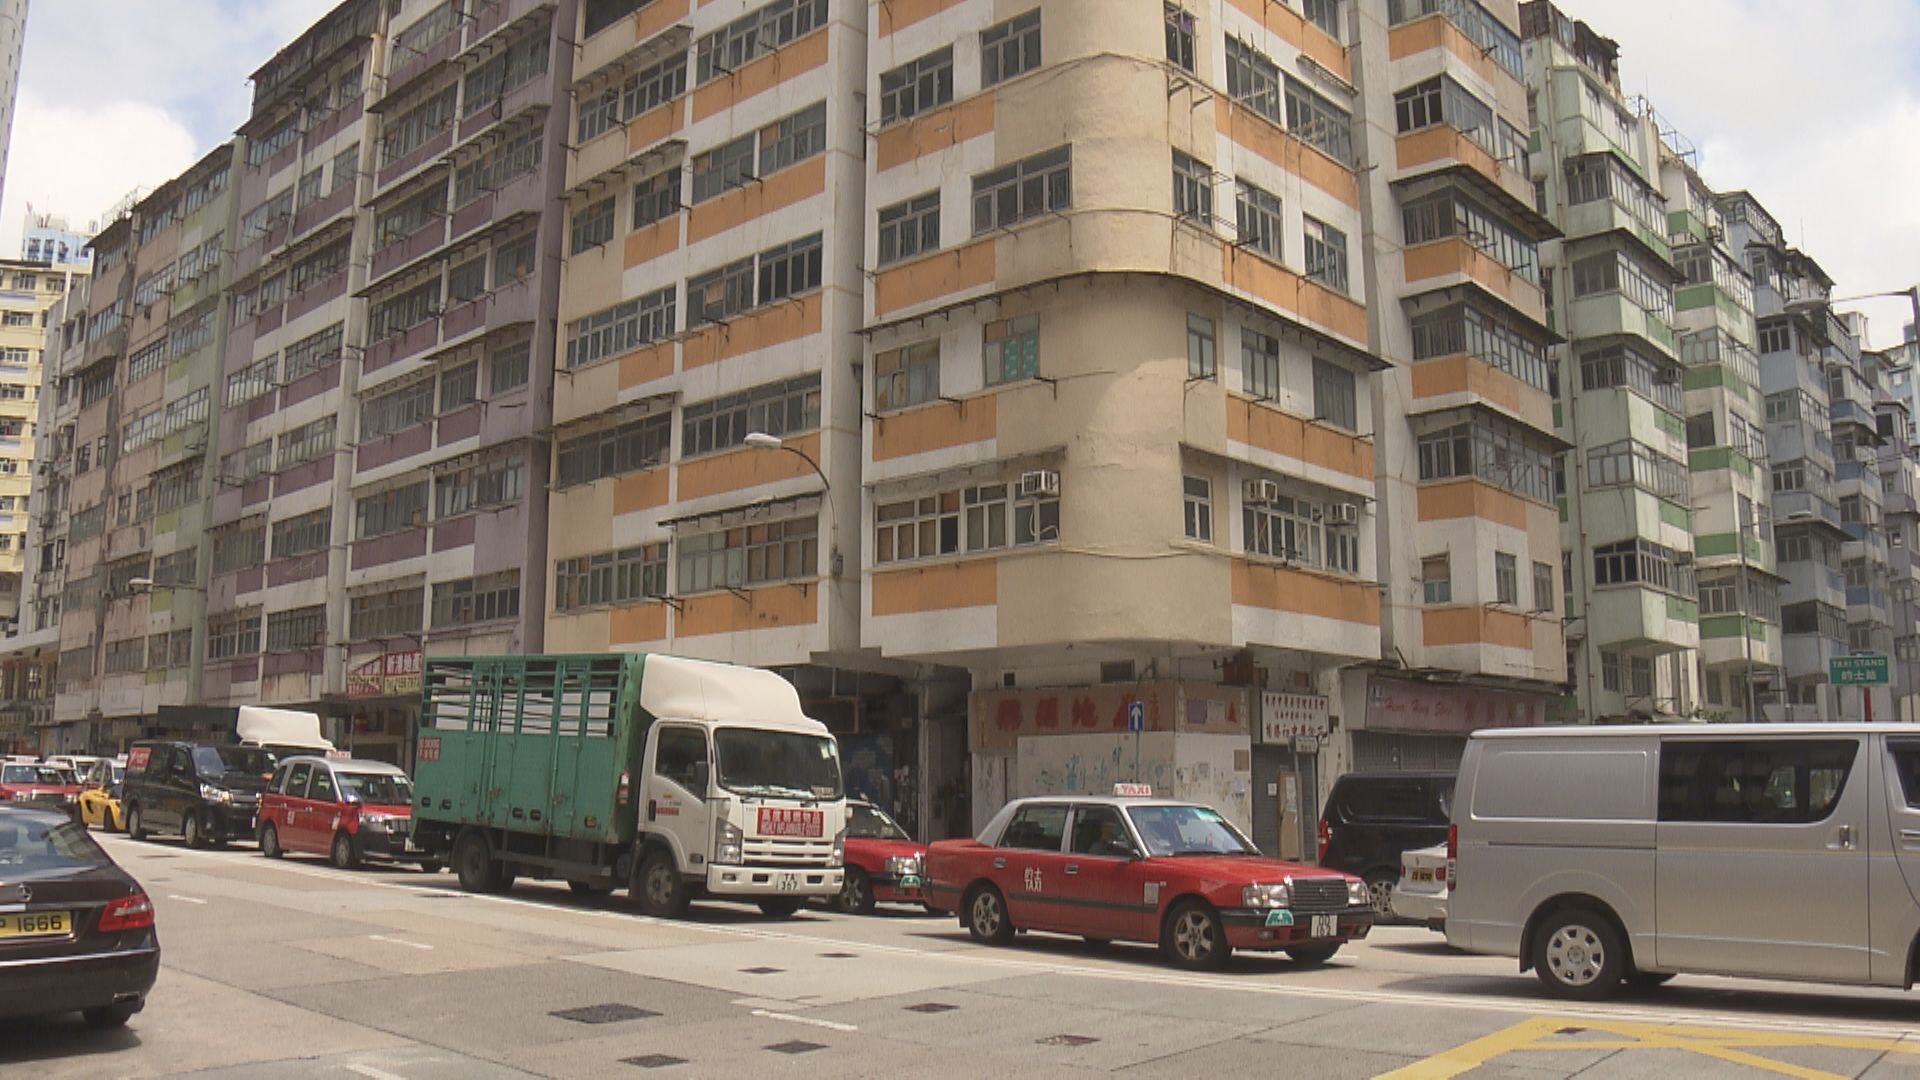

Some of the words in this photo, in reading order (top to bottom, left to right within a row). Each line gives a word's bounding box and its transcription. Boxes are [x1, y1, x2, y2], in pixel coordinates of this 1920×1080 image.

[1833, 660, 1852, 668] TAXI
[1855, 658, 1885, 667] STAND
[1841, 670, 1877, 681] 的士站
[1120, 784, 1149, 795] TAXI
[784, 873, 795, 881] TA
[1024, 867, 1042, 880] 的士
[1025, 879, 1042, 892] TAXI
[17, 914, 62, 932] 1666
